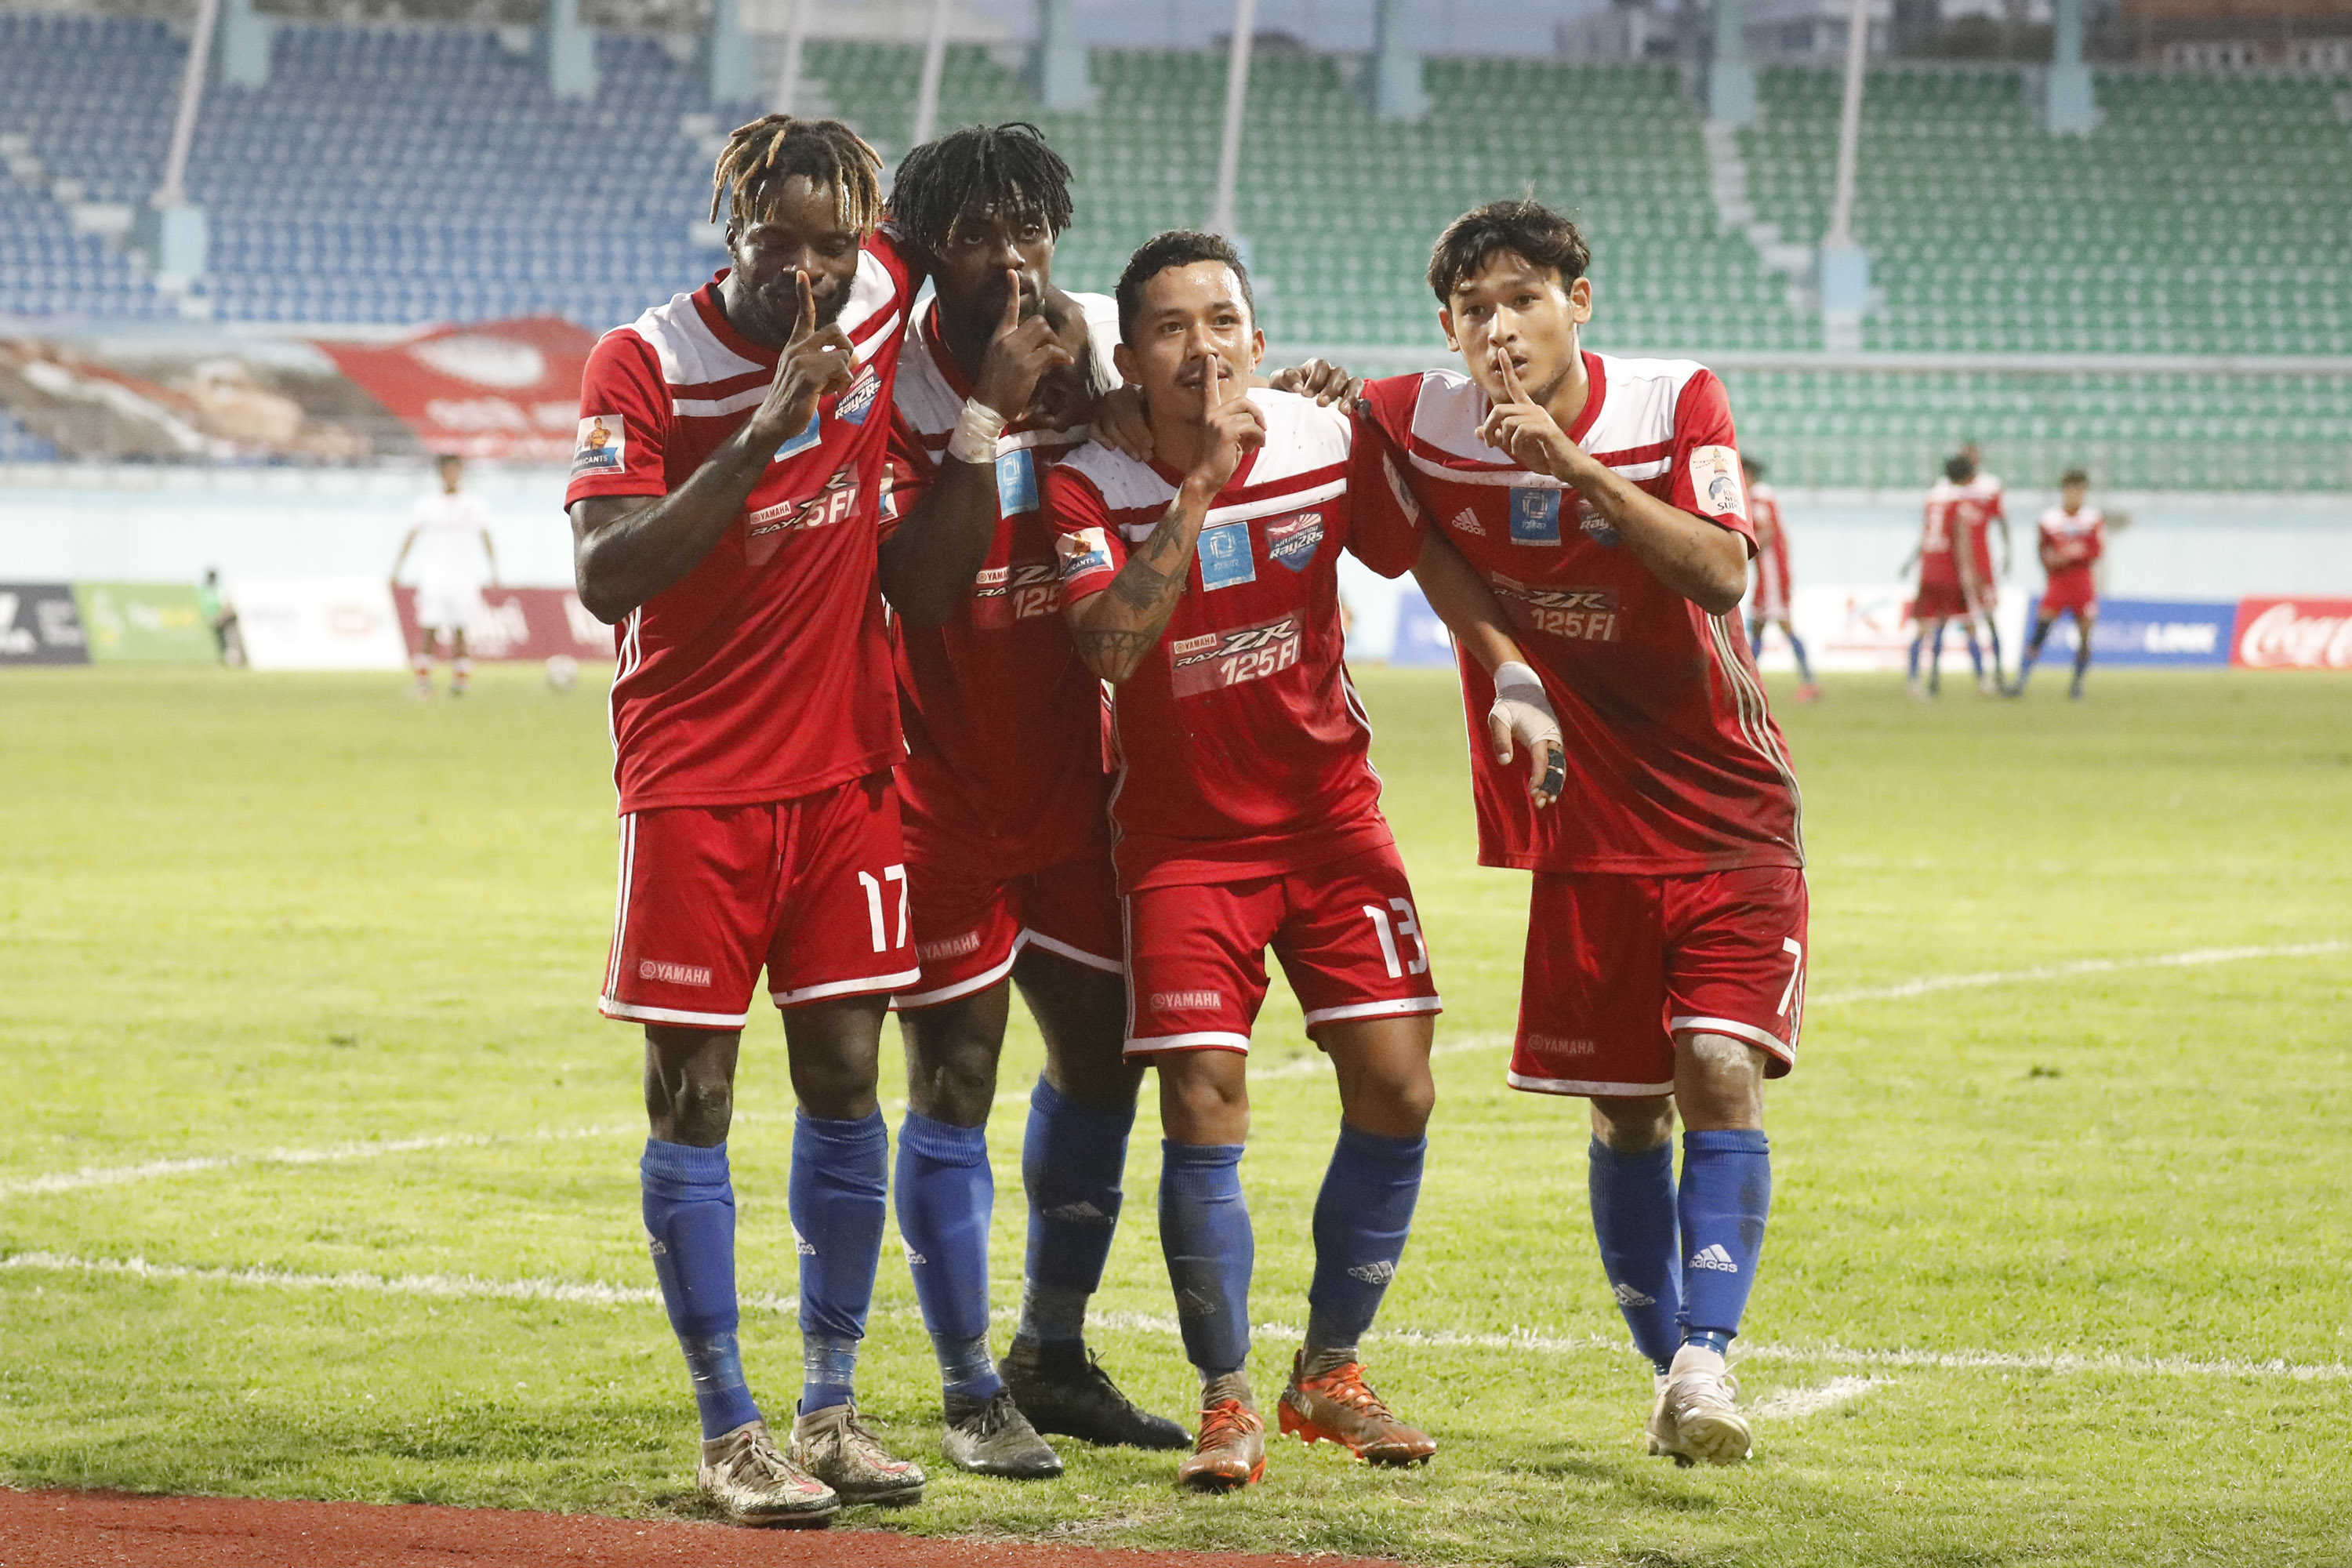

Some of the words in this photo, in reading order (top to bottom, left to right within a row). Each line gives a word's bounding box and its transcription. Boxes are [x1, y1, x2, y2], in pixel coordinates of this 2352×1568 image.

[760, 506, 790, 520] YAMAHA
[1451, 519, 1486, 536] adidas
[1185, 635, 1215, 650] YAMAHA
[858, 862, 908, 953] 17
[1362, 896, 1428, 979] 13
[924, 934, 980, 959] YAMAHA
[658, 964, 710, 985] YAMAHA
[1777, 936, 1802, 1018] 7
[1165, 993, 1221, 1007] YAMAHA
[1544, 1037, 1595, 1054] YAMAHA
[1688, 1259, 1738, 1273] adidas
